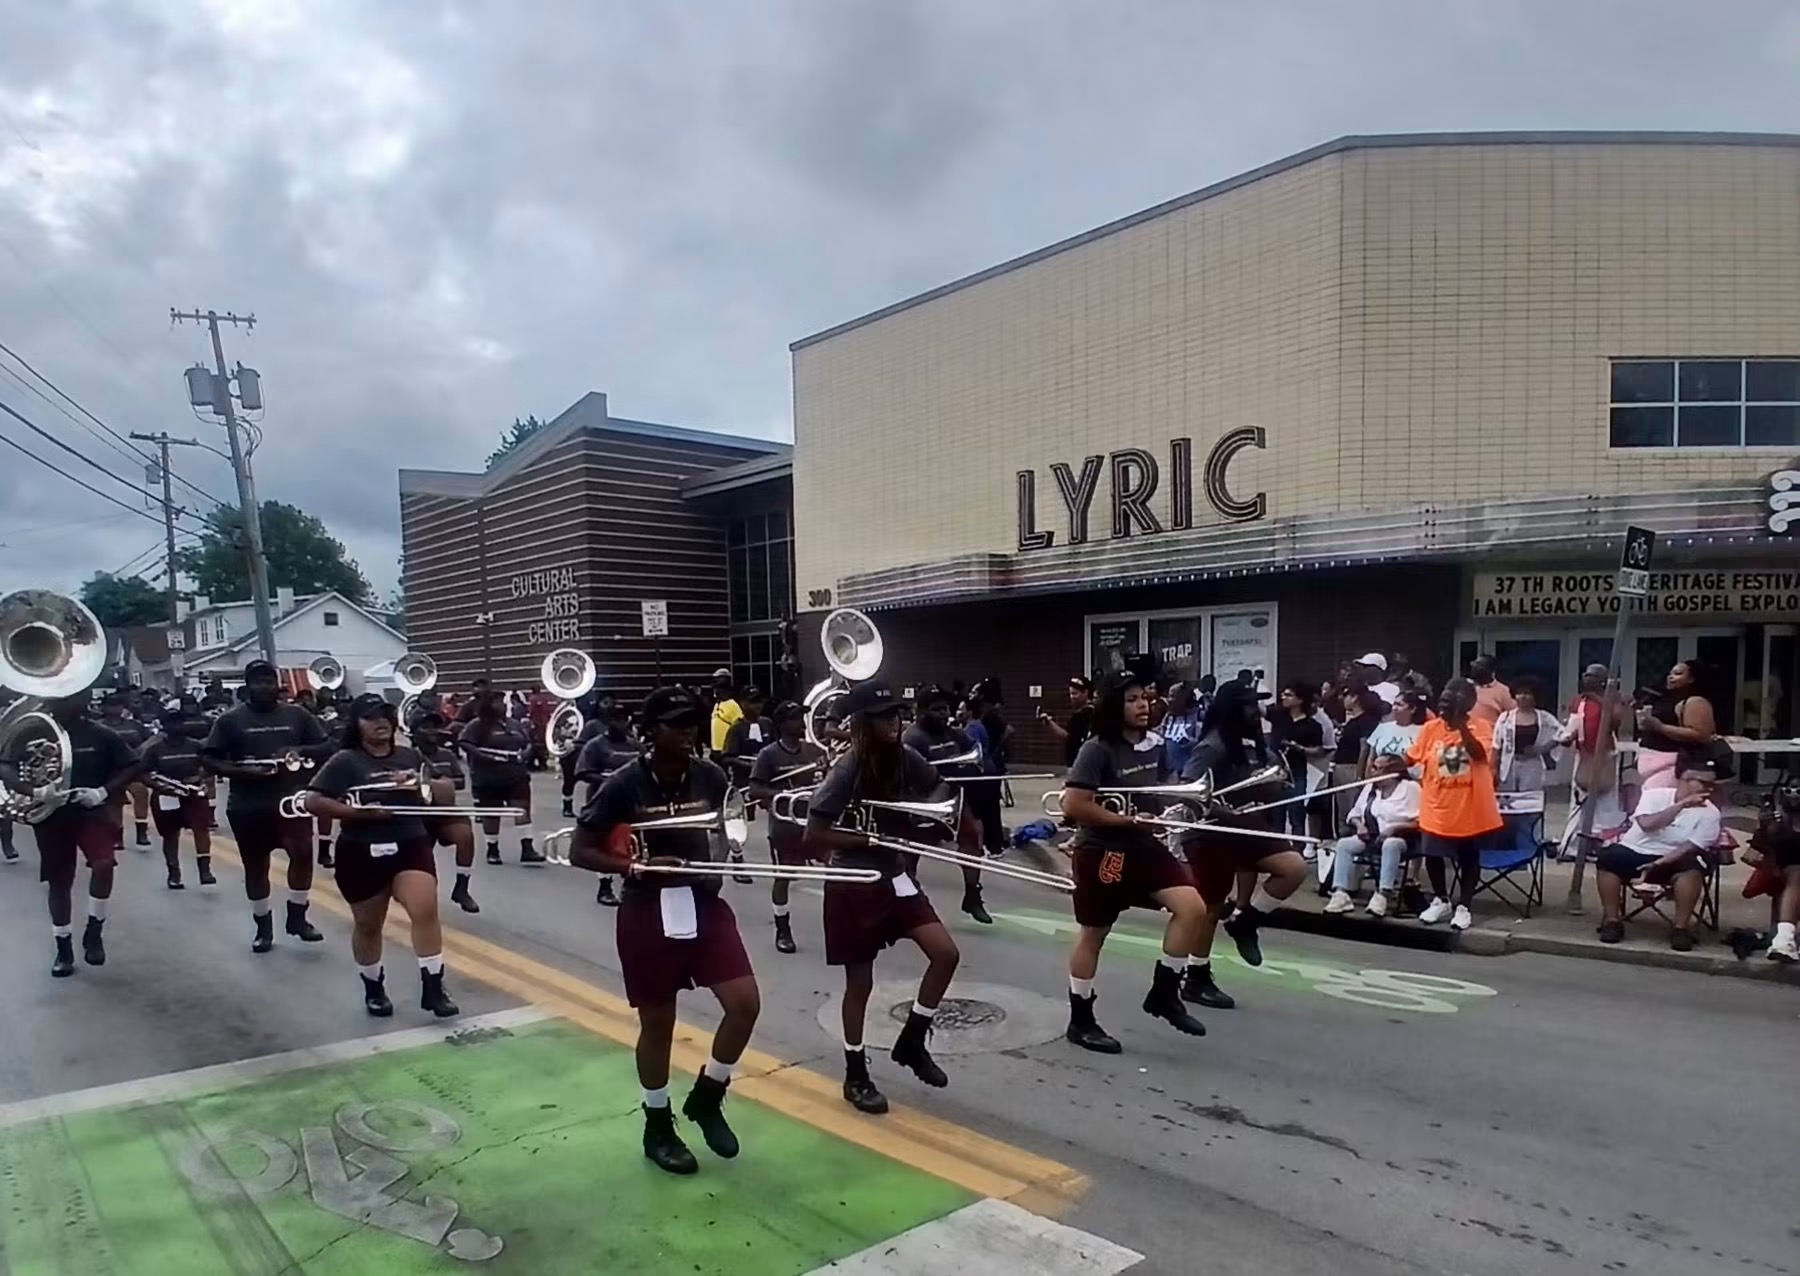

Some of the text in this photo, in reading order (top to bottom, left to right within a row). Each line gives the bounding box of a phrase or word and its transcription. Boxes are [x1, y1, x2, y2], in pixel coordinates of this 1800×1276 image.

[1017, 426, 1266, 551] LYRIC
[511, 567, 577, 598] CULTURAL
[1494, 576, 1516, 594] 37
[1521, 576, 1544, 593] TH
[1552, 575, 1614, 592] ROOTS
[1649, 573, 1726, 590] ERITAGE
[544, 593, 579, 618] ARTS
[808, 588, 832, 608] 300
[1474, 598, 1480, 615] I
[1485, 598, 1512, 615] AM
[1519, 597, 1590, 614] LEGACY
[1597, 595, 1658, 613] YOTH
[1664, 594, 1733, 611] GOSPEL
[528, 619, 580, 644] CENTER
[1162, 643, 1192, 663] TRAP
